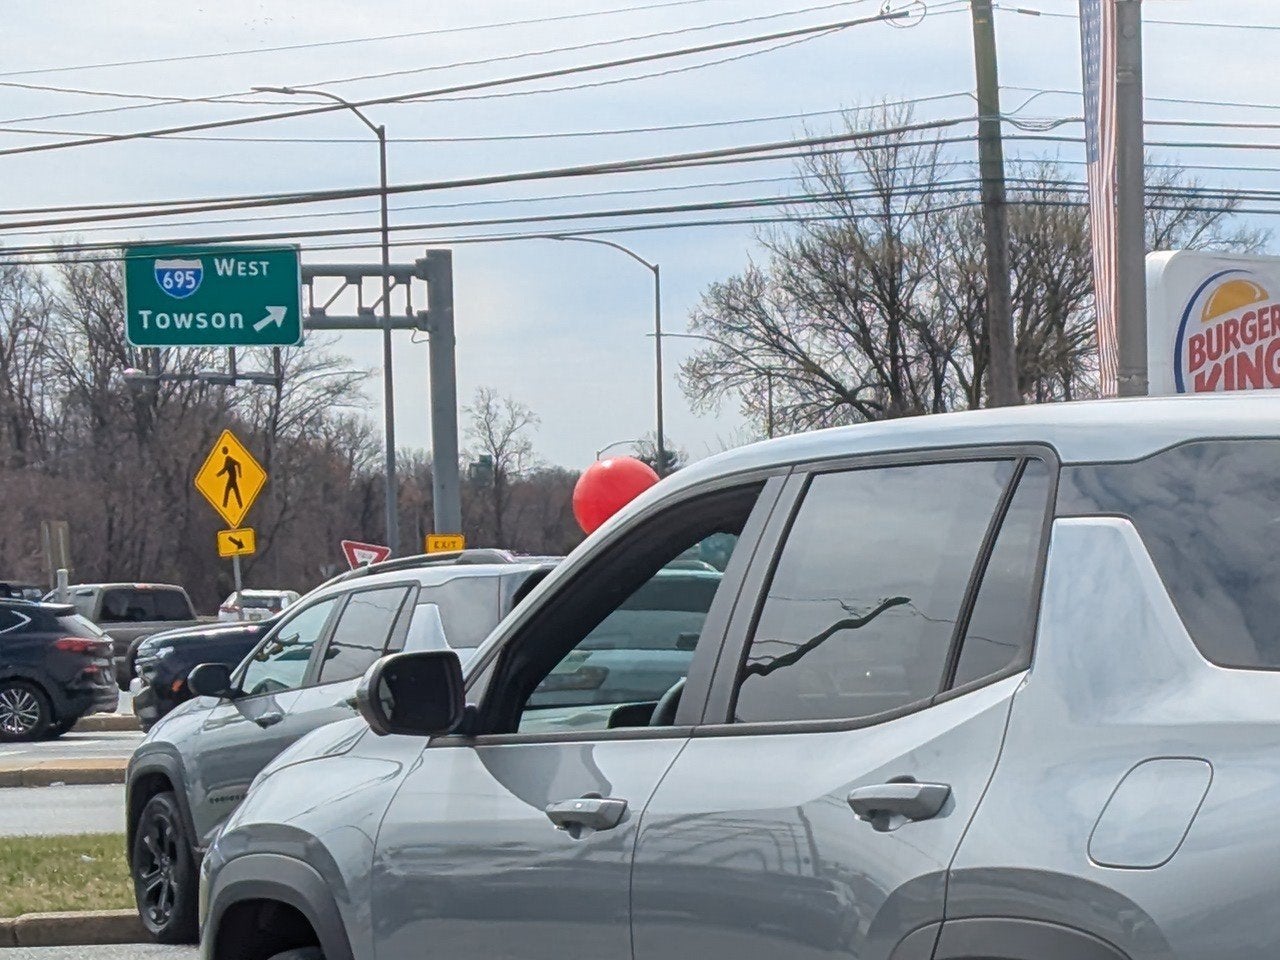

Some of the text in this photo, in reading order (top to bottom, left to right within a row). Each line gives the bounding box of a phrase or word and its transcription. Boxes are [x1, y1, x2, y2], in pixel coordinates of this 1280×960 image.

[214, 257, 270, 277] WEST
[162, 270, 196, 290] 695
[138, 309, 244, 330] Towson
